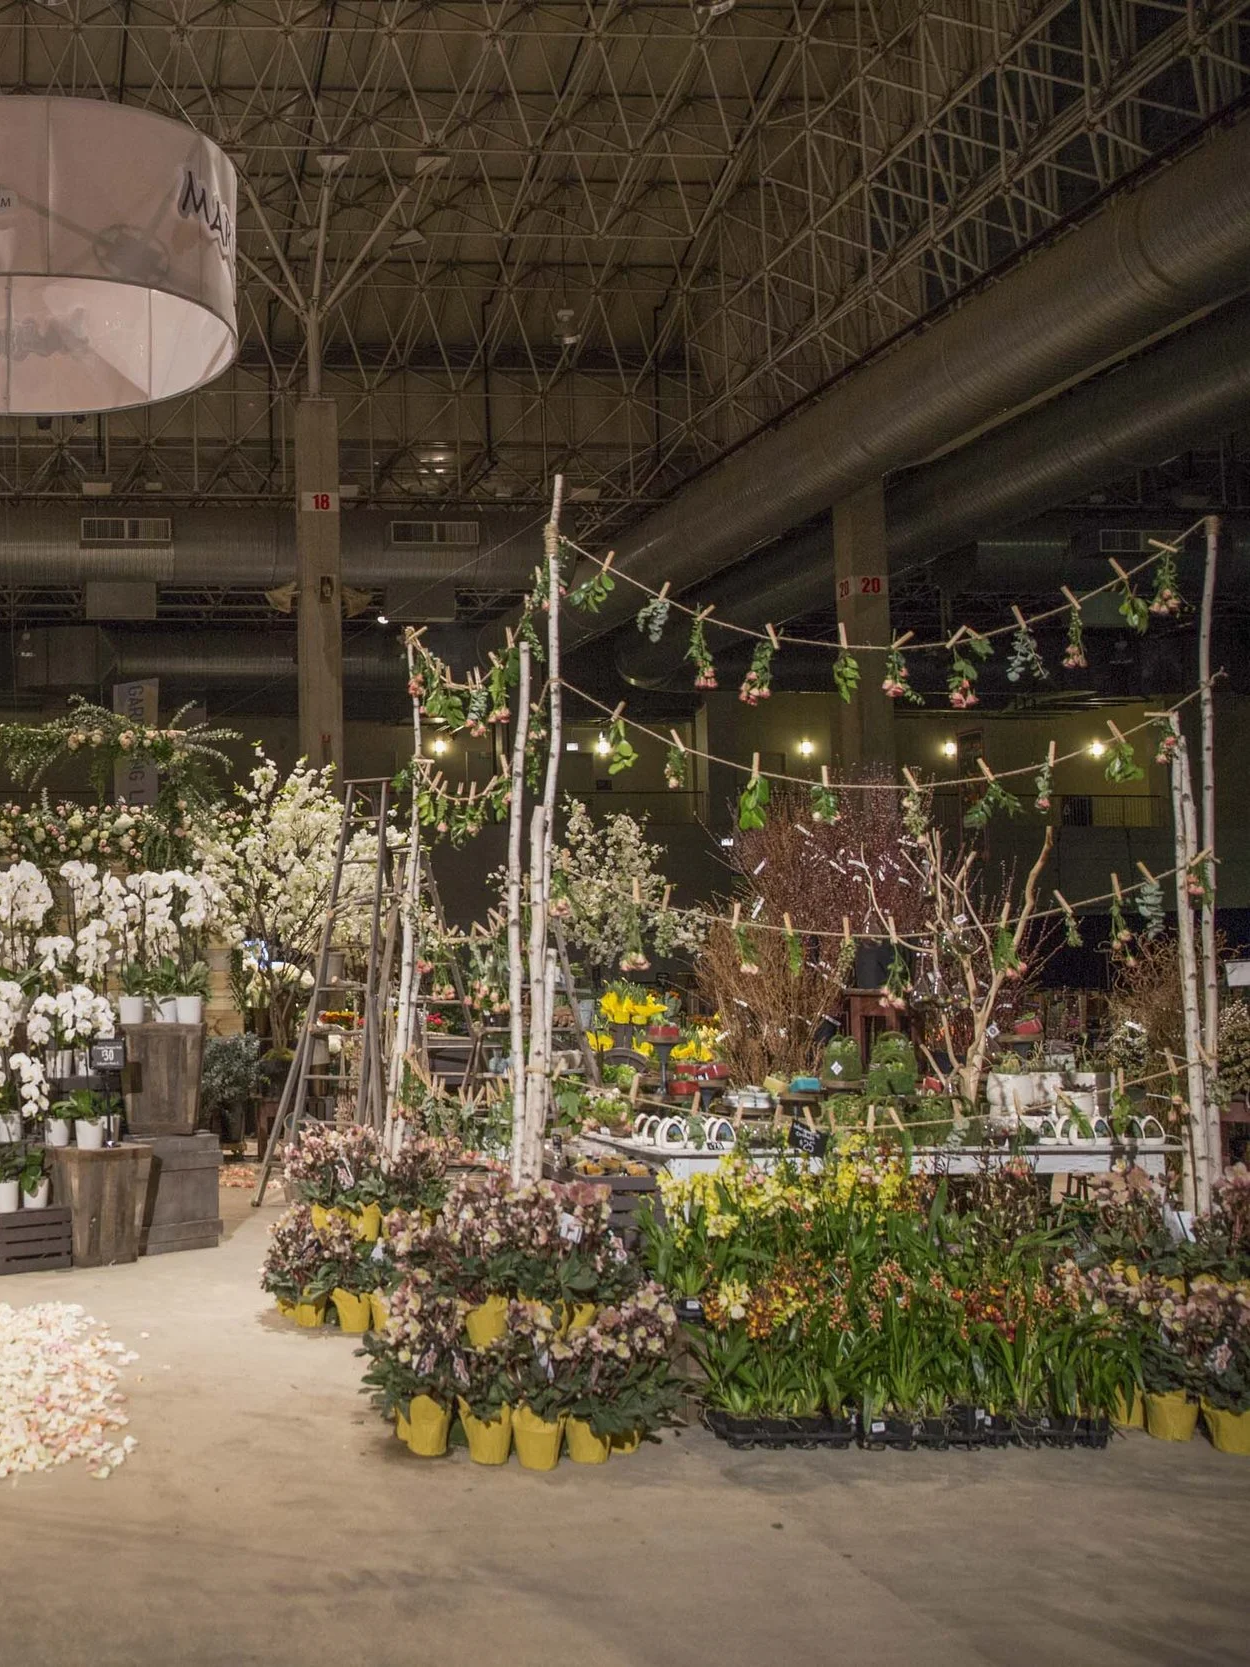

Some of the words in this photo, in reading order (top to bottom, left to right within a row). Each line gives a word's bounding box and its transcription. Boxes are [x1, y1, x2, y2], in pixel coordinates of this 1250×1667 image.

[312, 493, 330, 510] 18
[840, 580, 849, 598] 20
[861, 577, 881, 594] 20
